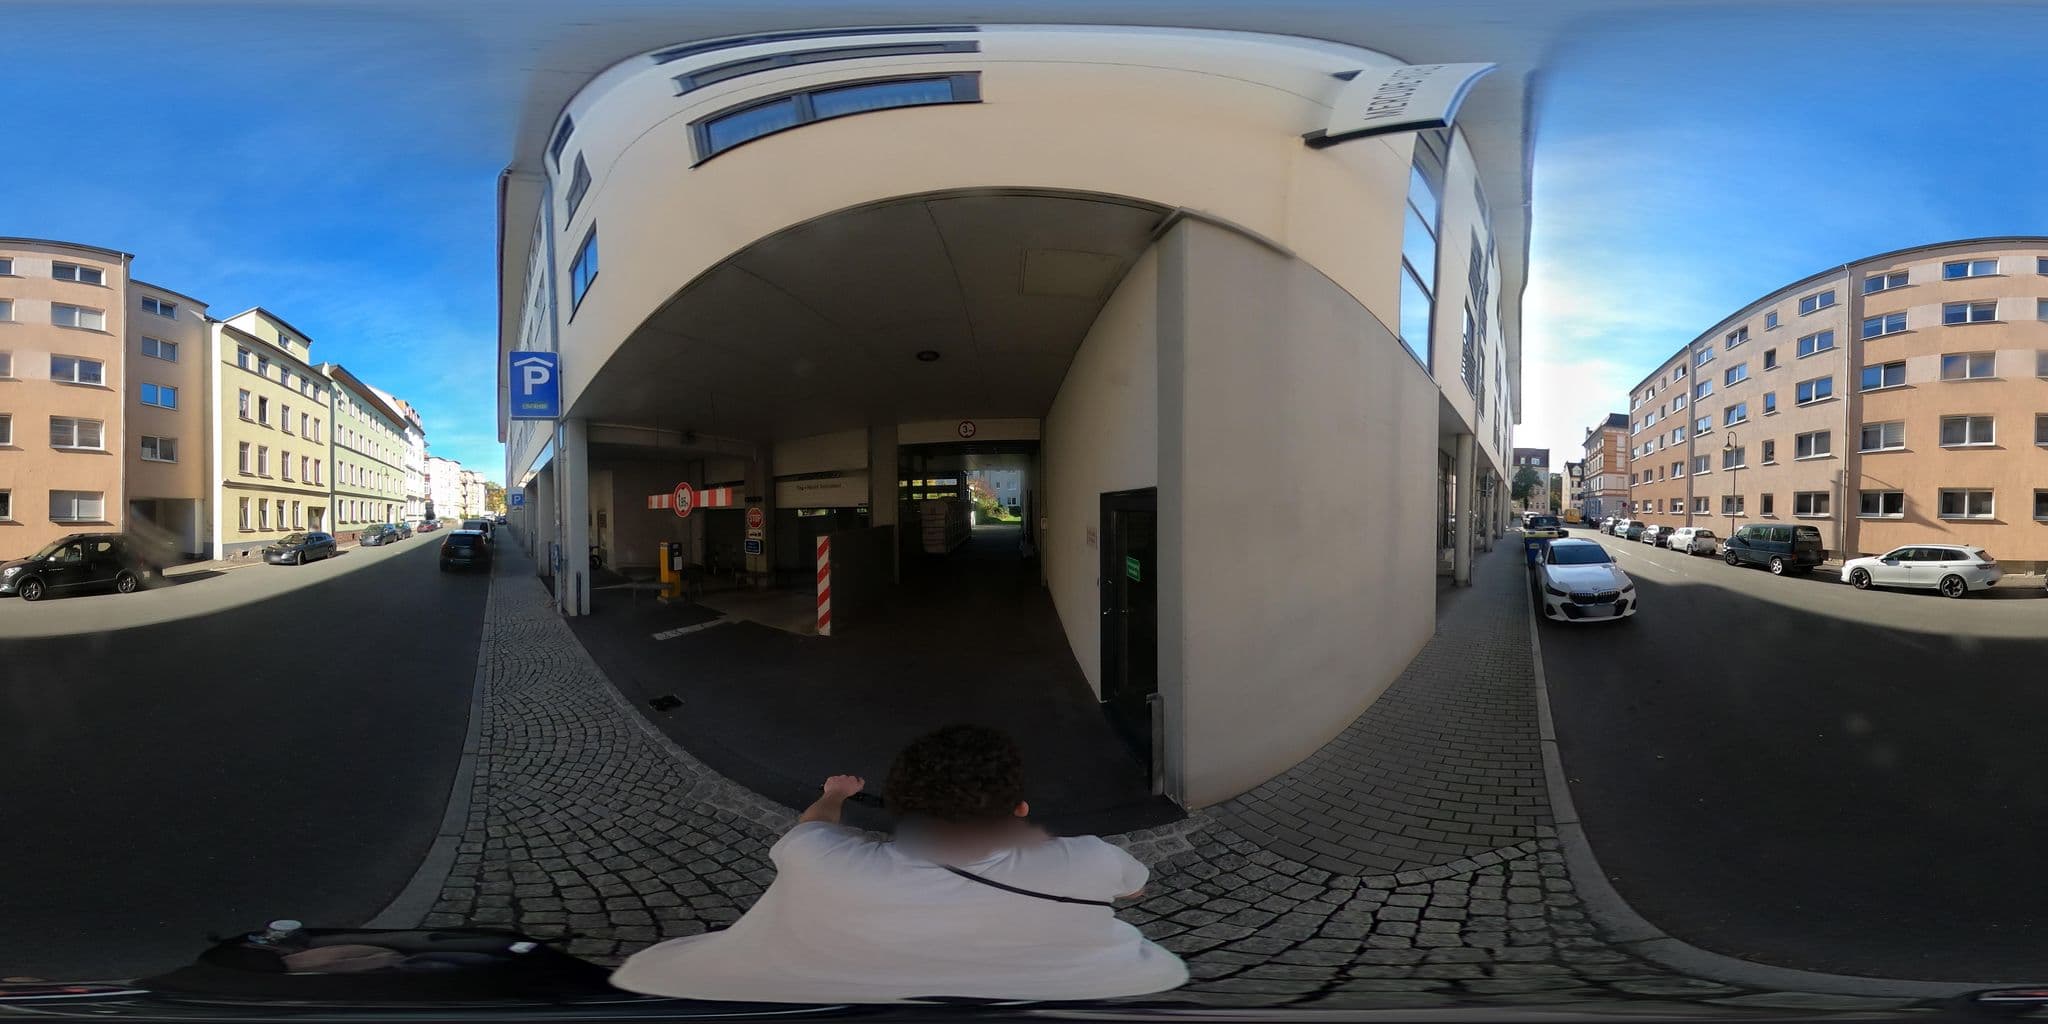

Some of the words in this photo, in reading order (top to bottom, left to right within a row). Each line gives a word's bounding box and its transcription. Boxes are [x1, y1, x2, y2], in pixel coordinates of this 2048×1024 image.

[1364, 81, 1423, 120] MERCURE
[524, 366, 550, 395] P
[514, 495, 521, 505] P
[749, 514, 762, 523] STOP
